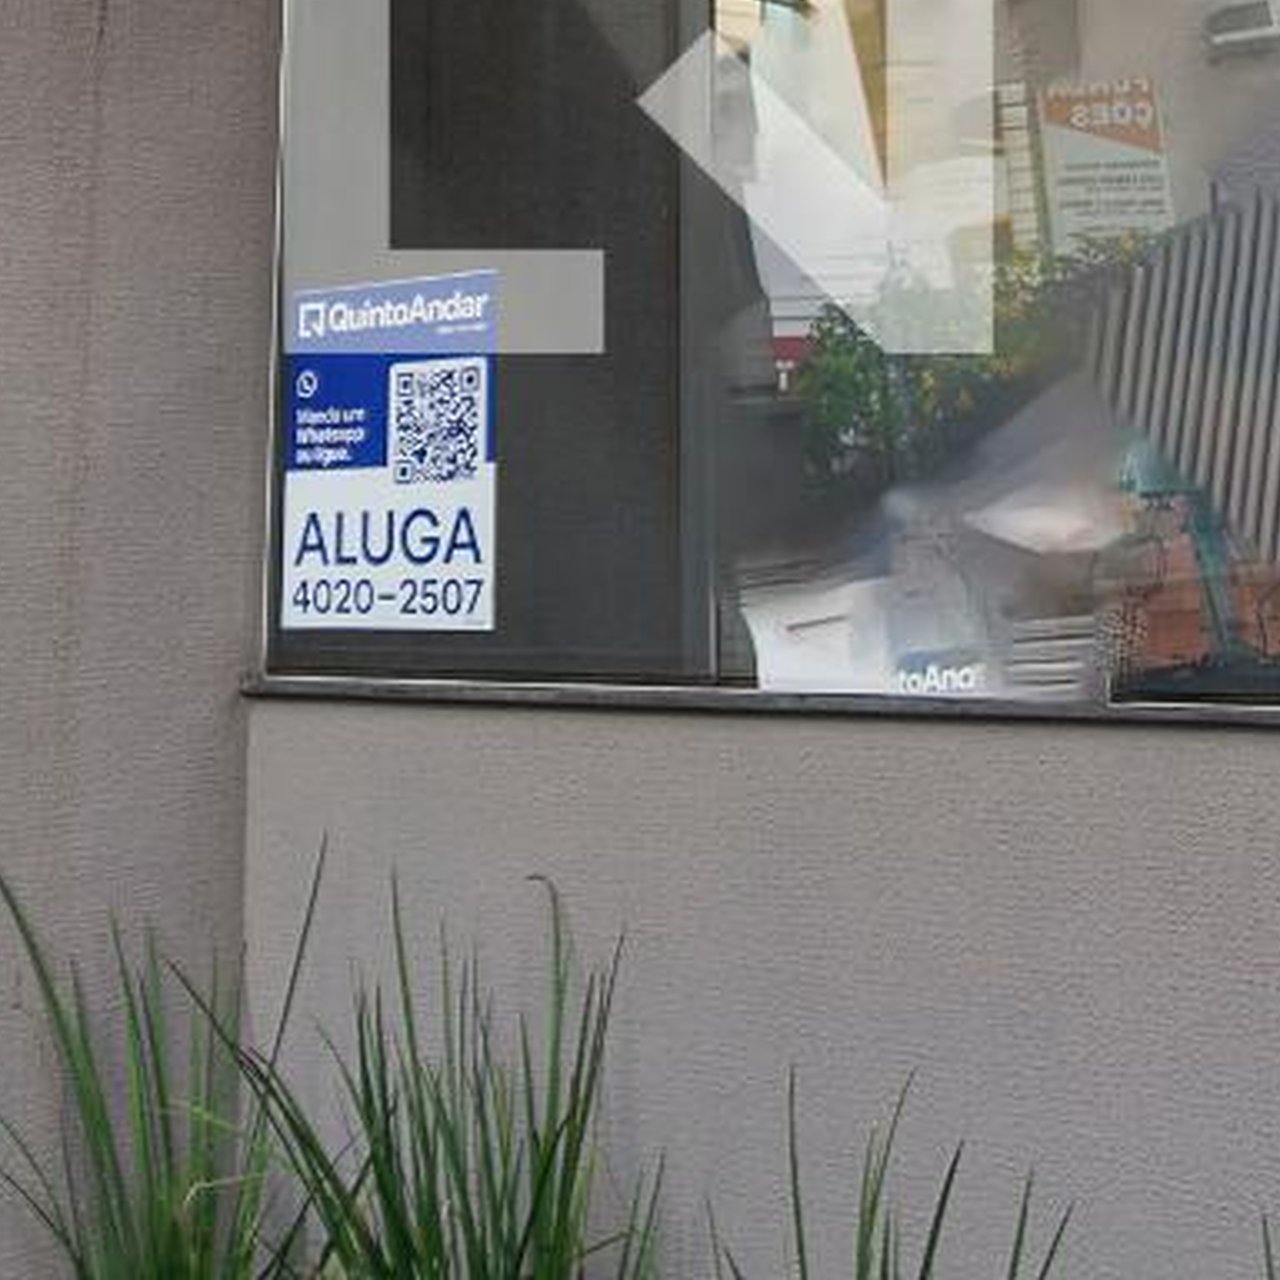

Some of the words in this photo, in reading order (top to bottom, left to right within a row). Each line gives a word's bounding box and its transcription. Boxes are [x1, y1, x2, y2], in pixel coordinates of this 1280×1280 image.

[329, 291, 489, 332] QuintoAndar
[294, 507, 483, 567] ALUGA
[293, 579, 484, 615] 4020-2507
